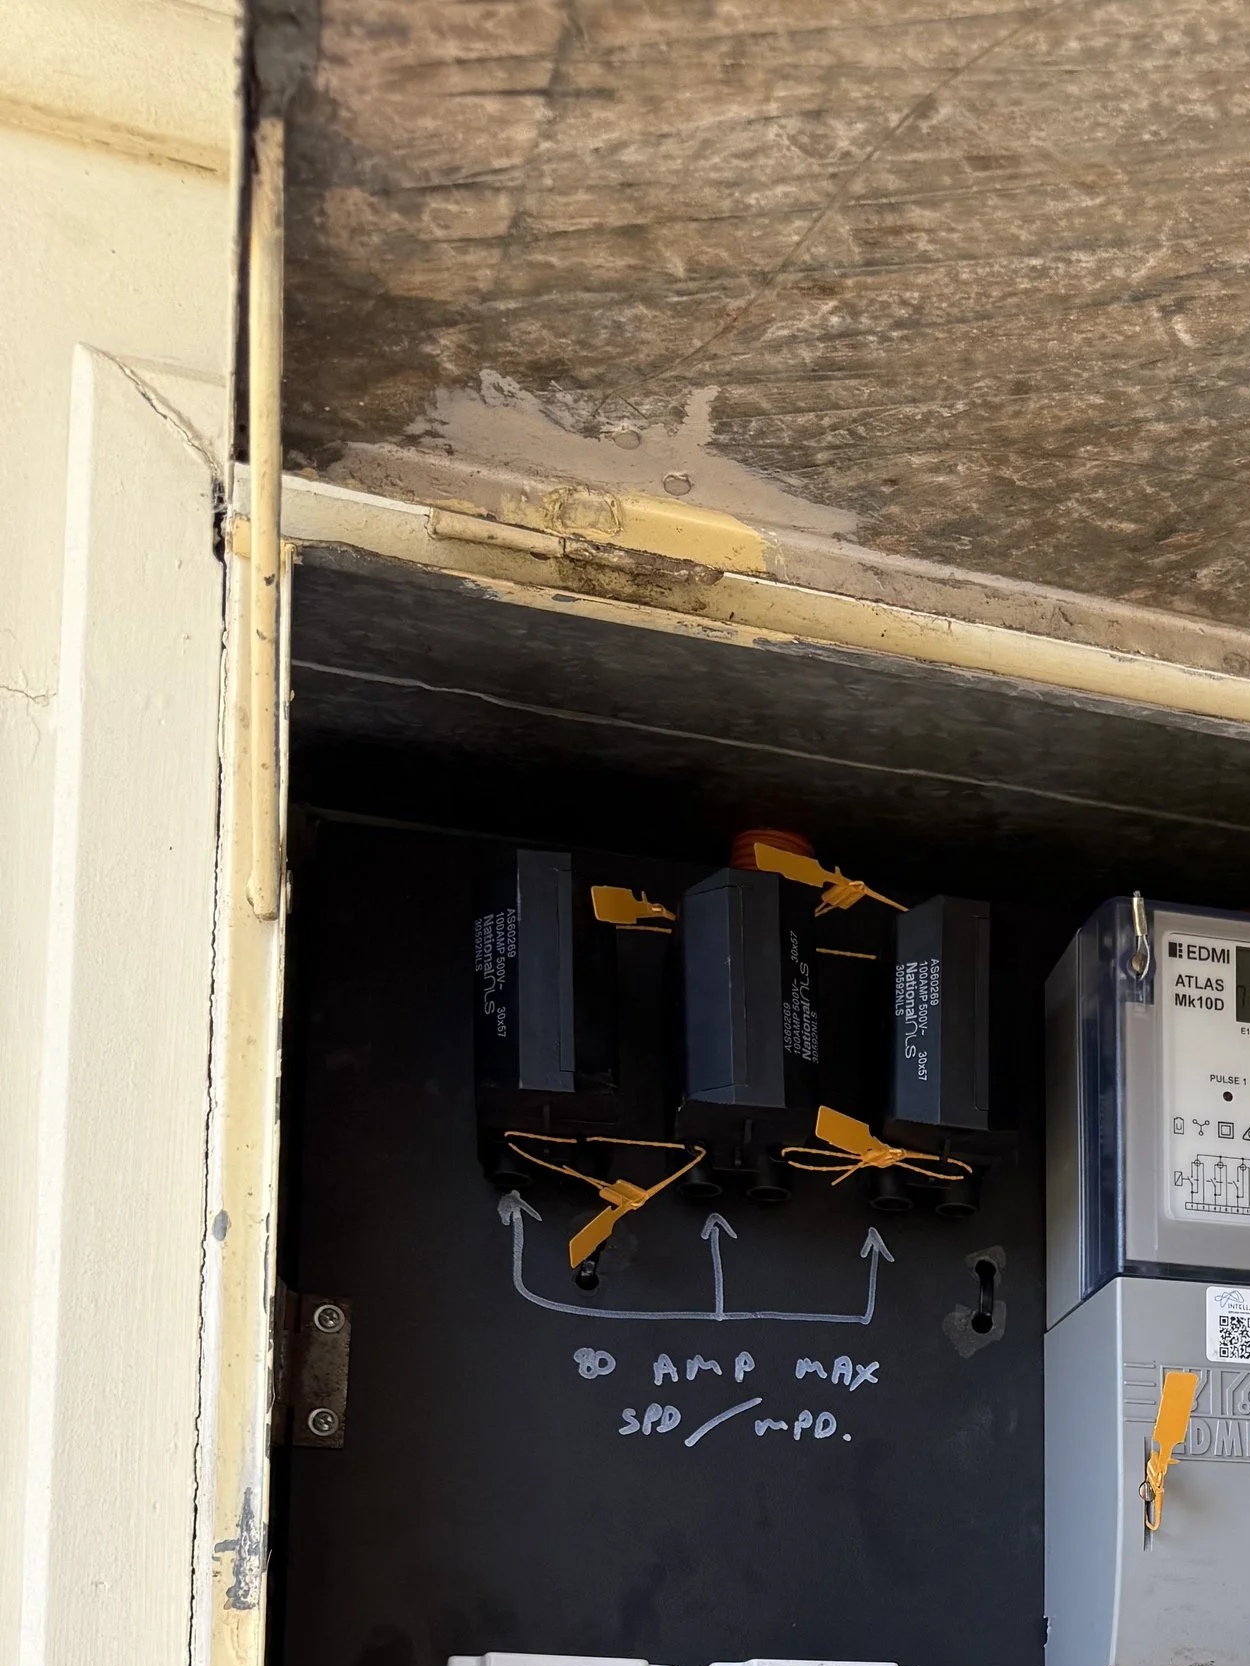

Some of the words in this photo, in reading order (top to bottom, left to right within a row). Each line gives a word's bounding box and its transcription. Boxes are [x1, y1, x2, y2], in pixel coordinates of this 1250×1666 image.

[1186, 944, 1230, 964] EDMI
[895, 964, 904, 1016] 30592NLS
[919, 961, 928, 1002] 100AMP
[930, 958, 940, 1006] AS60269
[1175, 974, 1224, 992] ATLAS
[1174, 993, 1225, 1011] Mk10D
[918, 1051, 928, 1080] 30x57
[1210, 1074, 1240, 1085] PULSE
